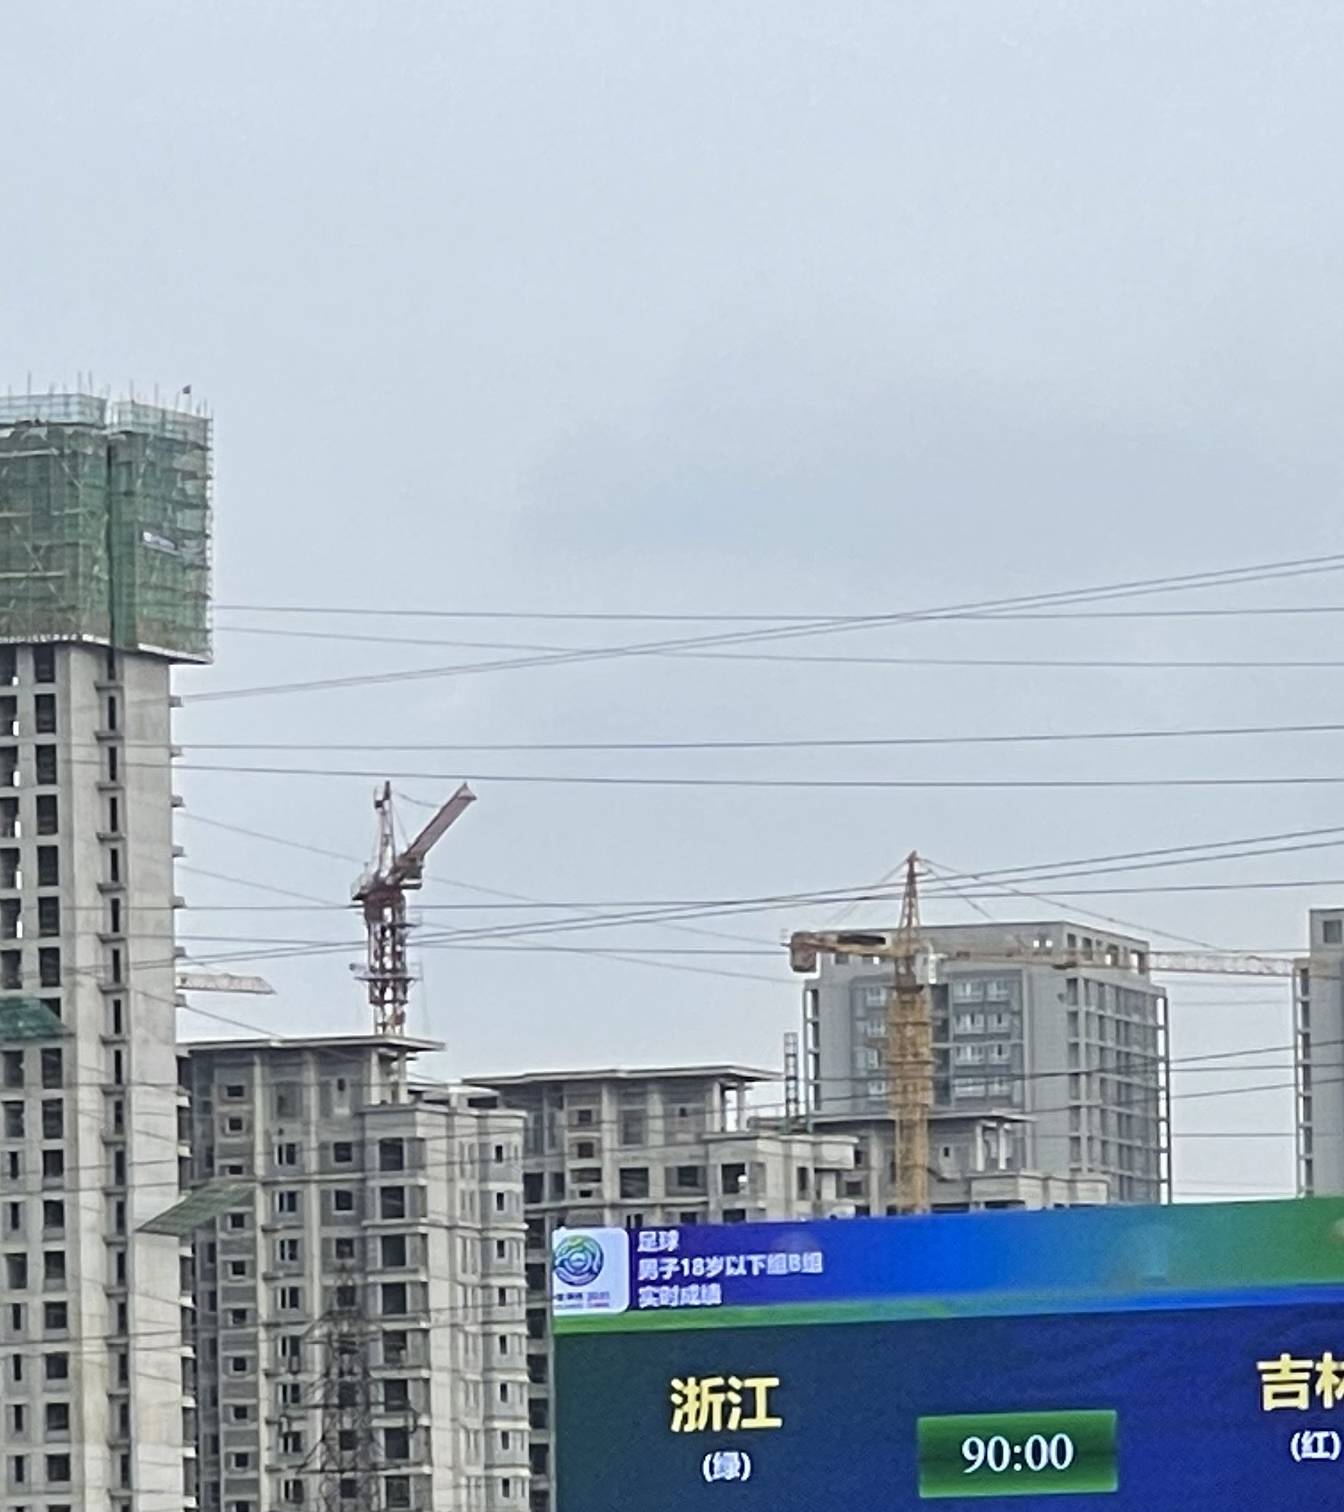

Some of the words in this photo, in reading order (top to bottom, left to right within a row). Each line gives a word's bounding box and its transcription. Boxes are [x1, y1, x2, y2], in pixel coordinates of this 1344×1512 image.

[638, 1229, 679, 1252] 足球
[670, 1376, 783, 1432] 浙江
[962, 1432, 1074, 1473] 90:00
[1290, 1430, 1342, 1462] (红)
